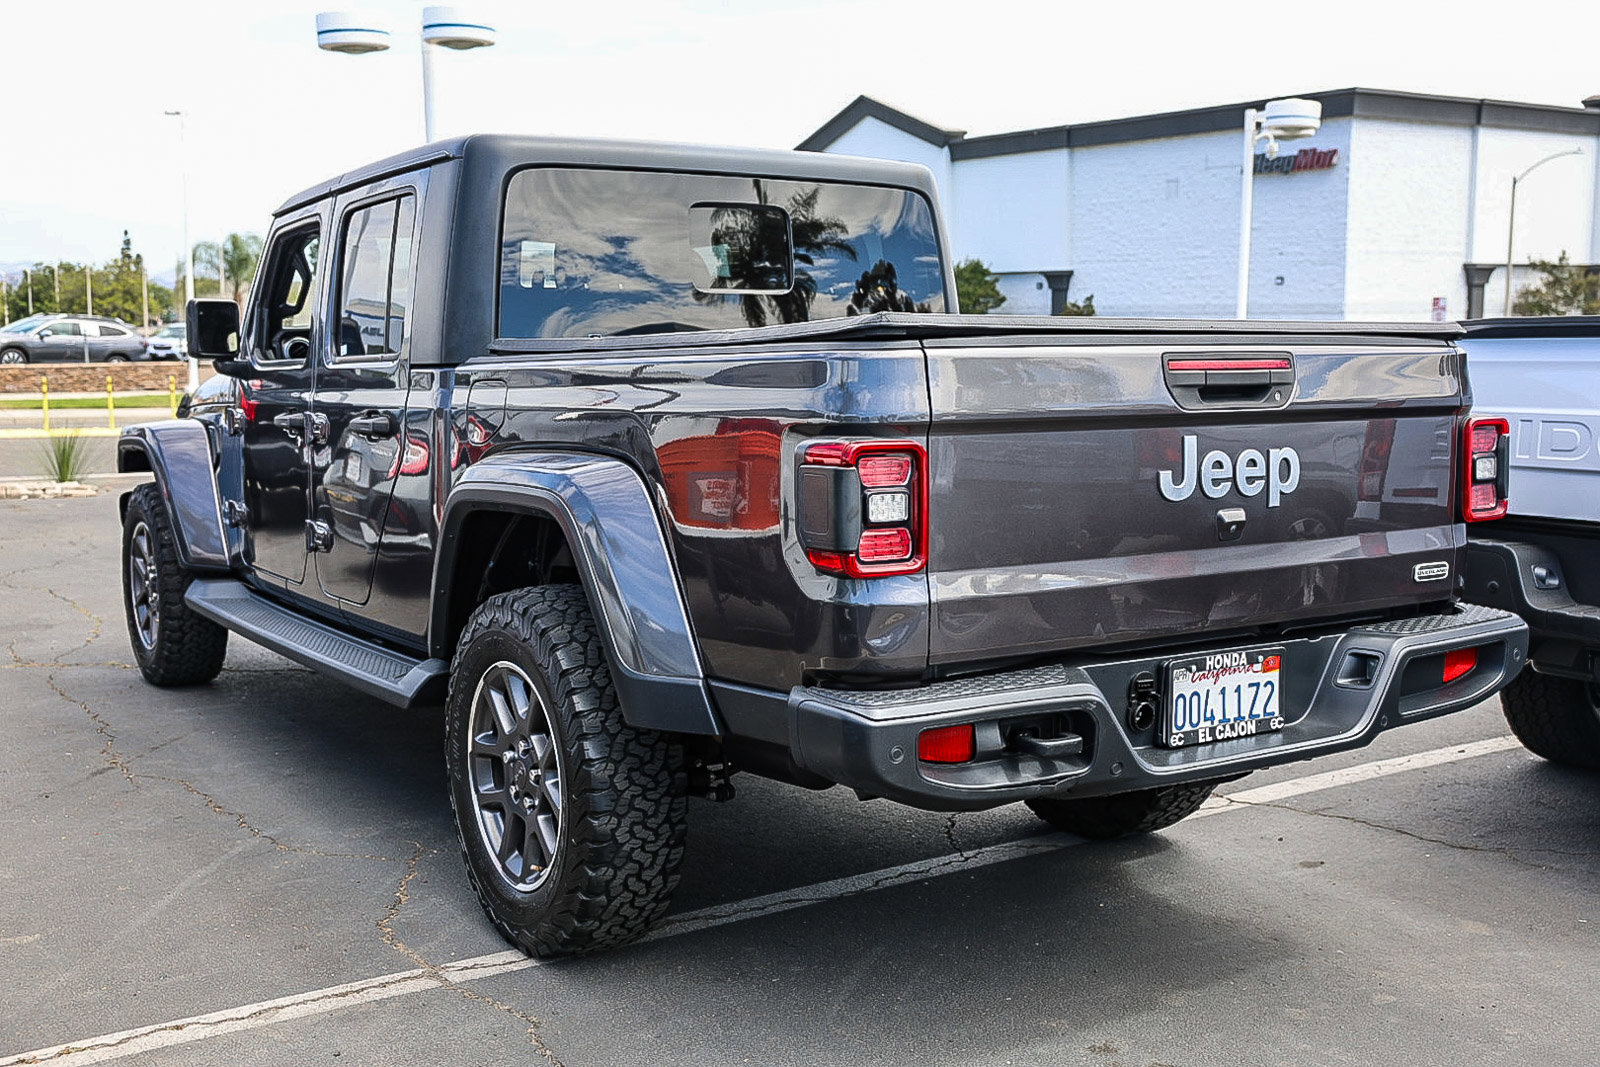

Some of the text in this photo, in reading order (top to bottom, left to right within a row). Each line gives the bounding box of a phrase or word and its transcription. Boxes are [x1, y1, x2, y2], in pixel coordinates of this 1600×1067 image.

[1515, 419, 1600, 462] ID
[1158, 434, 1300, 507] Jeep
[1206, 652, 1247, 670] HONDA
[1191, 663, 1262, 685] California
[1198, 719, 1256, 743] EL CAJON
